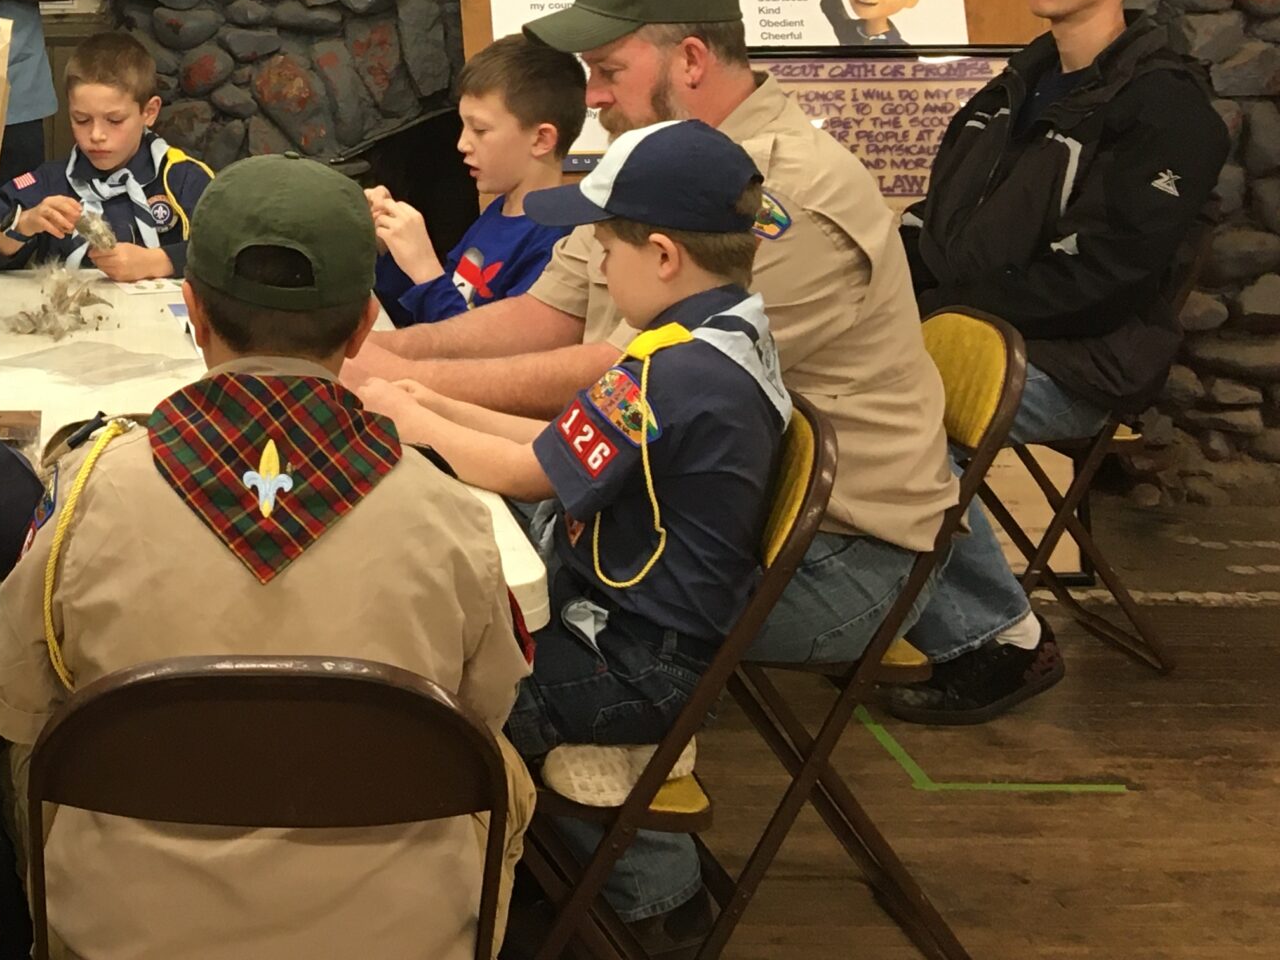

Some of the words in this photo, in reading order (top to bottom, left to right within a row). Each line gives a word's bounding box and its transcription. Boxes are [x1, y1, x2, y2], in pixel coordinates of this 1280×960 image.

[530, 2, 545, 11] my
[758, 6, 781, 15] Kind
[759, 18, 804, 28] Obedient
[760, 31, 802, 41] Cheerful
[768, 63, 824, 78] SCOUT
[828, 64, 877, 78] OATH
[880, 64, 906, 78] OR
[911, 62, 993, 77] PROMISE
[797, 90, 846, 102] HONOR
[851, 88, 859, 102] I
[862, 89, 894, 101] WILL
[898, 89, 918, 101] DO
[924, 89, 953, 100] MY
[803, 103, 847, 117] DUTY
[852, 103, 872, 115] TO
[881, 103, 919, 115] GOD
[922, 103, 955, 114] AND
[871, 117, 902, 129] THE
[909, 116, 952, 127] SCOU
[855, 130, 910, 142] PEOPLE
[916, 129, 934, 141] AT
[877, 175, 927, 193] LAW
[561, 408, 610, 470] 126
